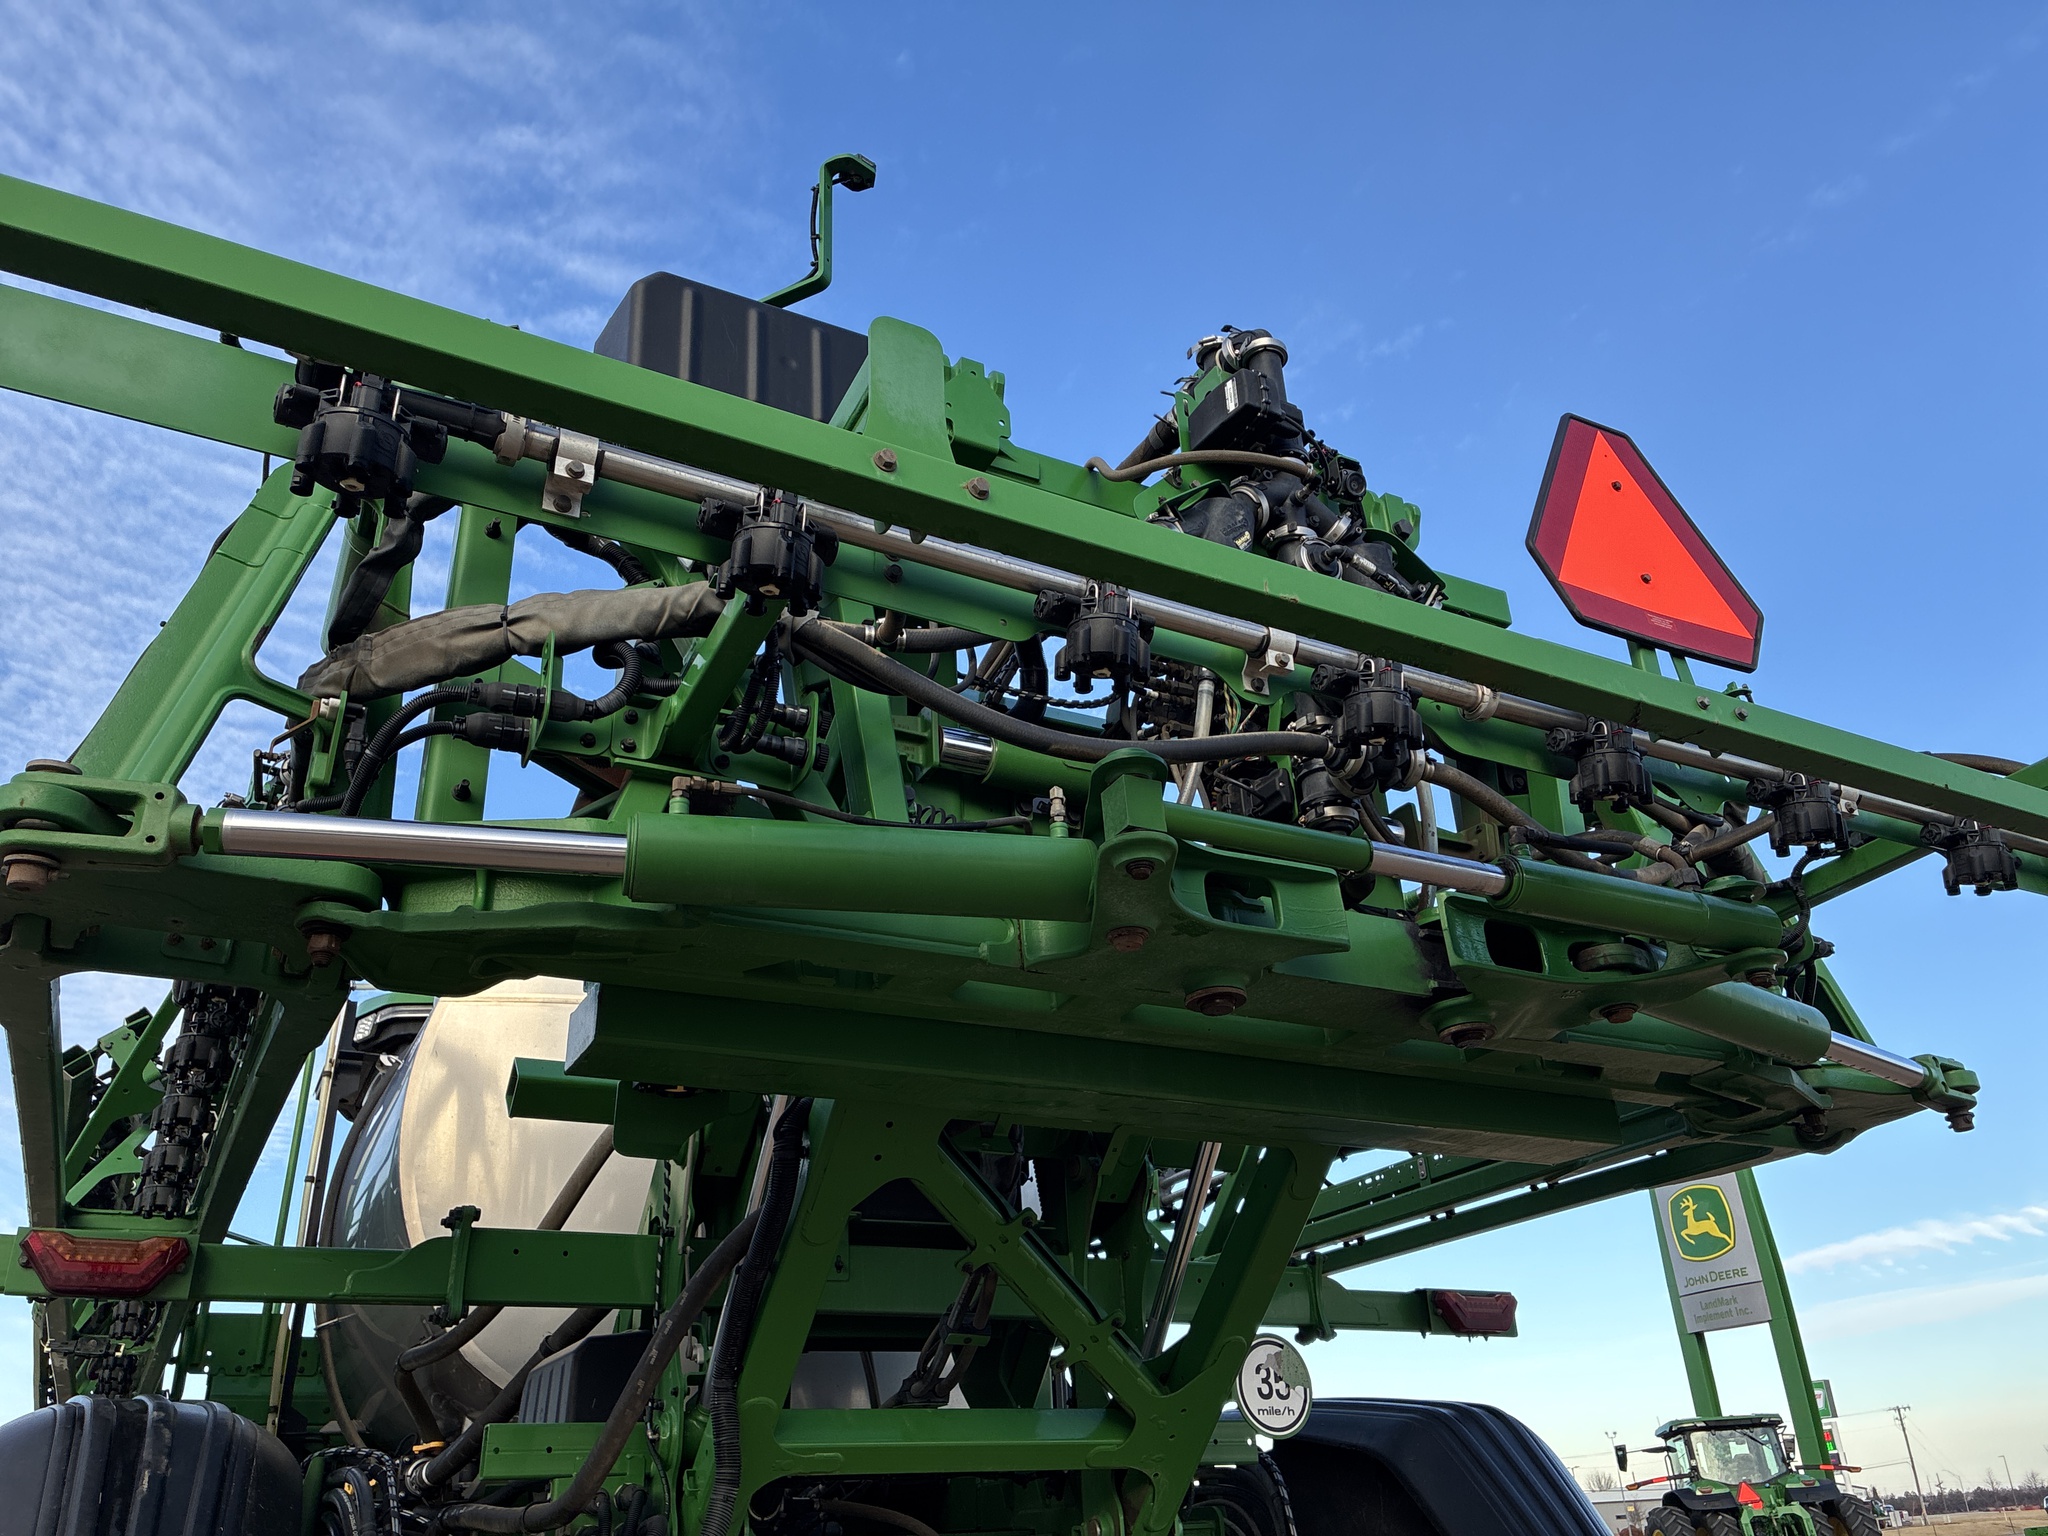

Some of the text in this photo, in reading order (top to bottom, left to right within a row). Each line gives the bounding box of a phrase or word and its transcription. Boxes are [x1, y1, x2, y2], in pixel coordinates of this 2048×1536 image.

[1684, 1267, 1749, 1288] JOHN DEERE
[1699, 1295, 1738, 1310] LandMark
[1693, 1306, 1753, 1324] Implement Inc.
[1257, 1406, 1296, 1416] mile/h
